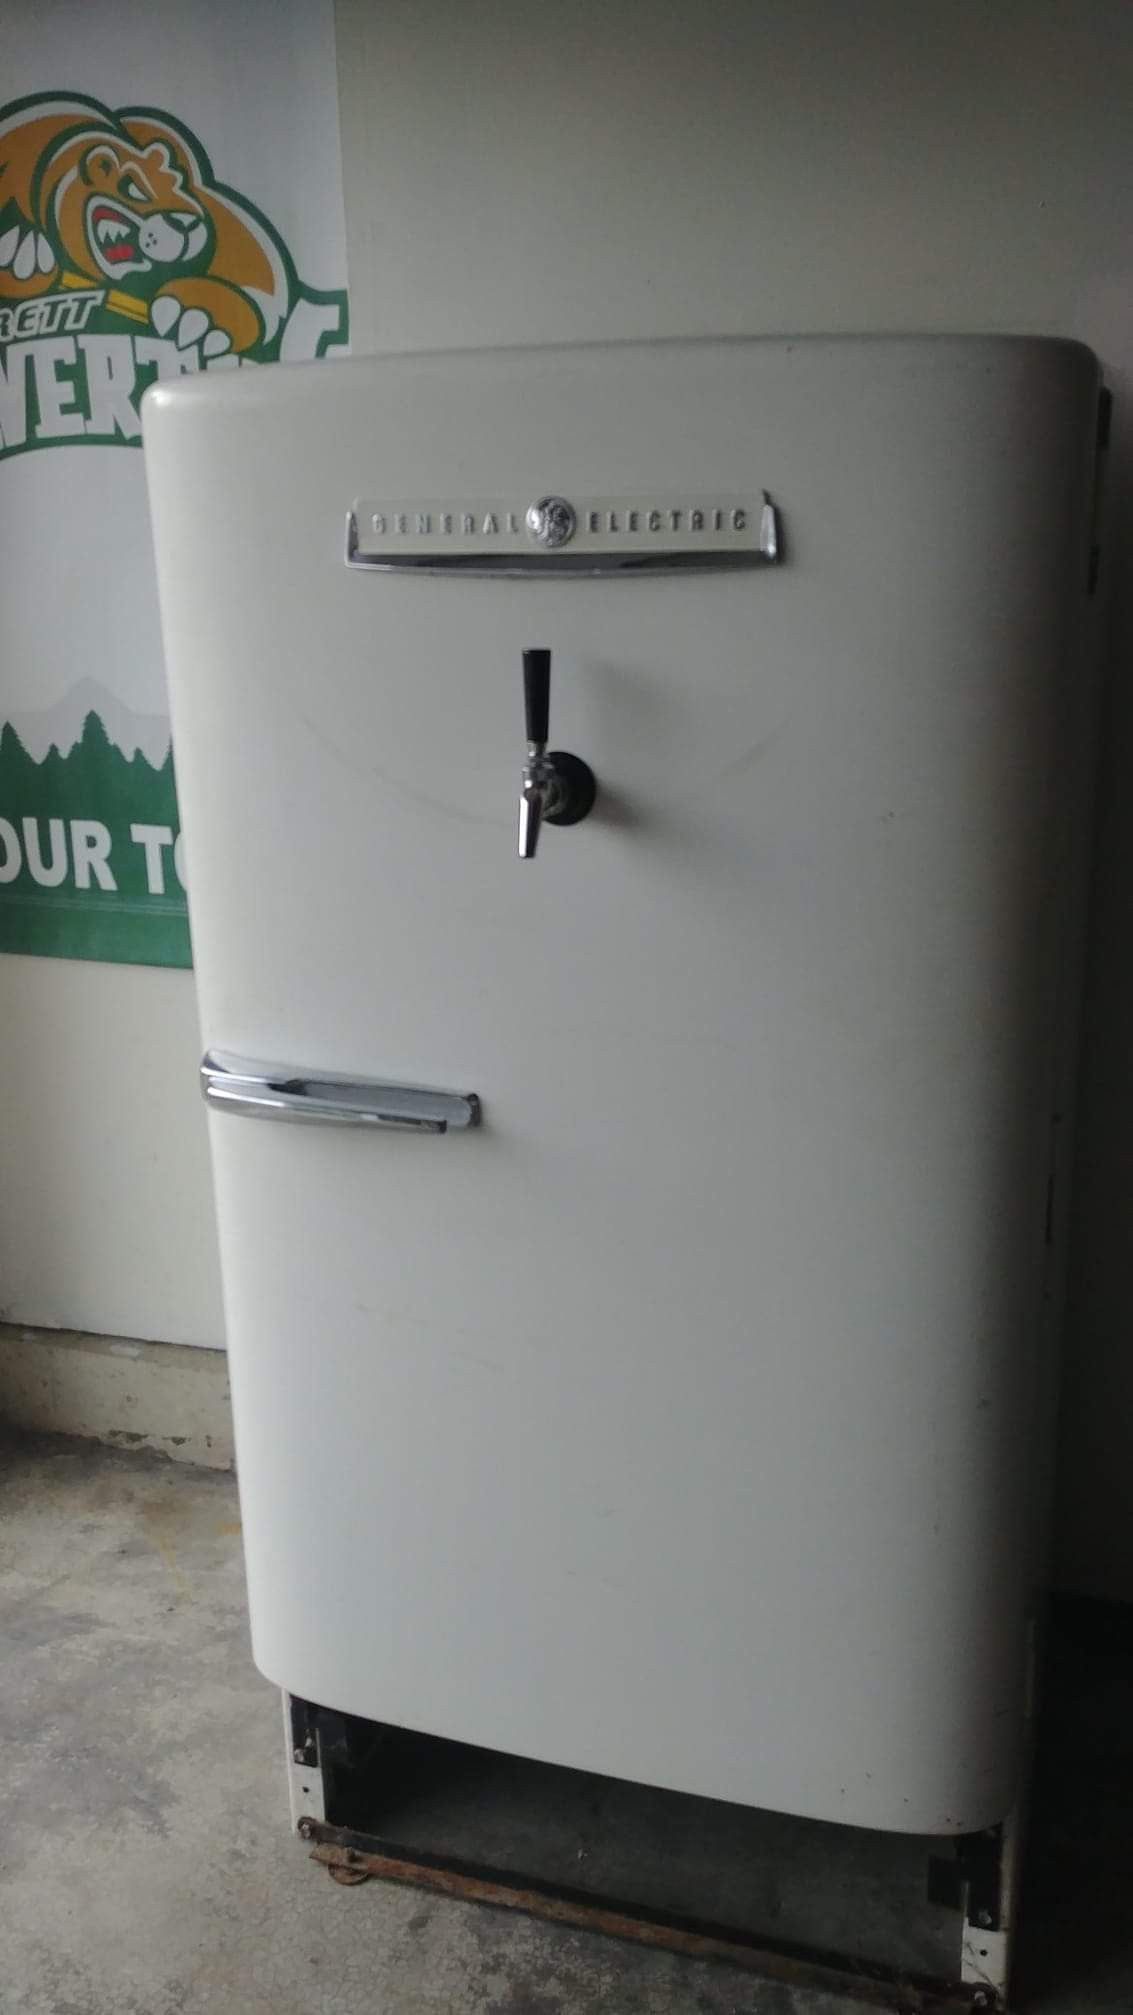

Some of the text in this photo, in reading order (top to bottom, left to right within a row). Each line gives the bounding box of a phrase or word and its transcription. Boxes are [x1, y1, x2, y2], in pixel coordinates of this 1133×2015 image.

[371, 512, 519, 535] GENERAL
[586, 509, 747, 533] ELECTRIC
[130, 823, 187, 894] T
